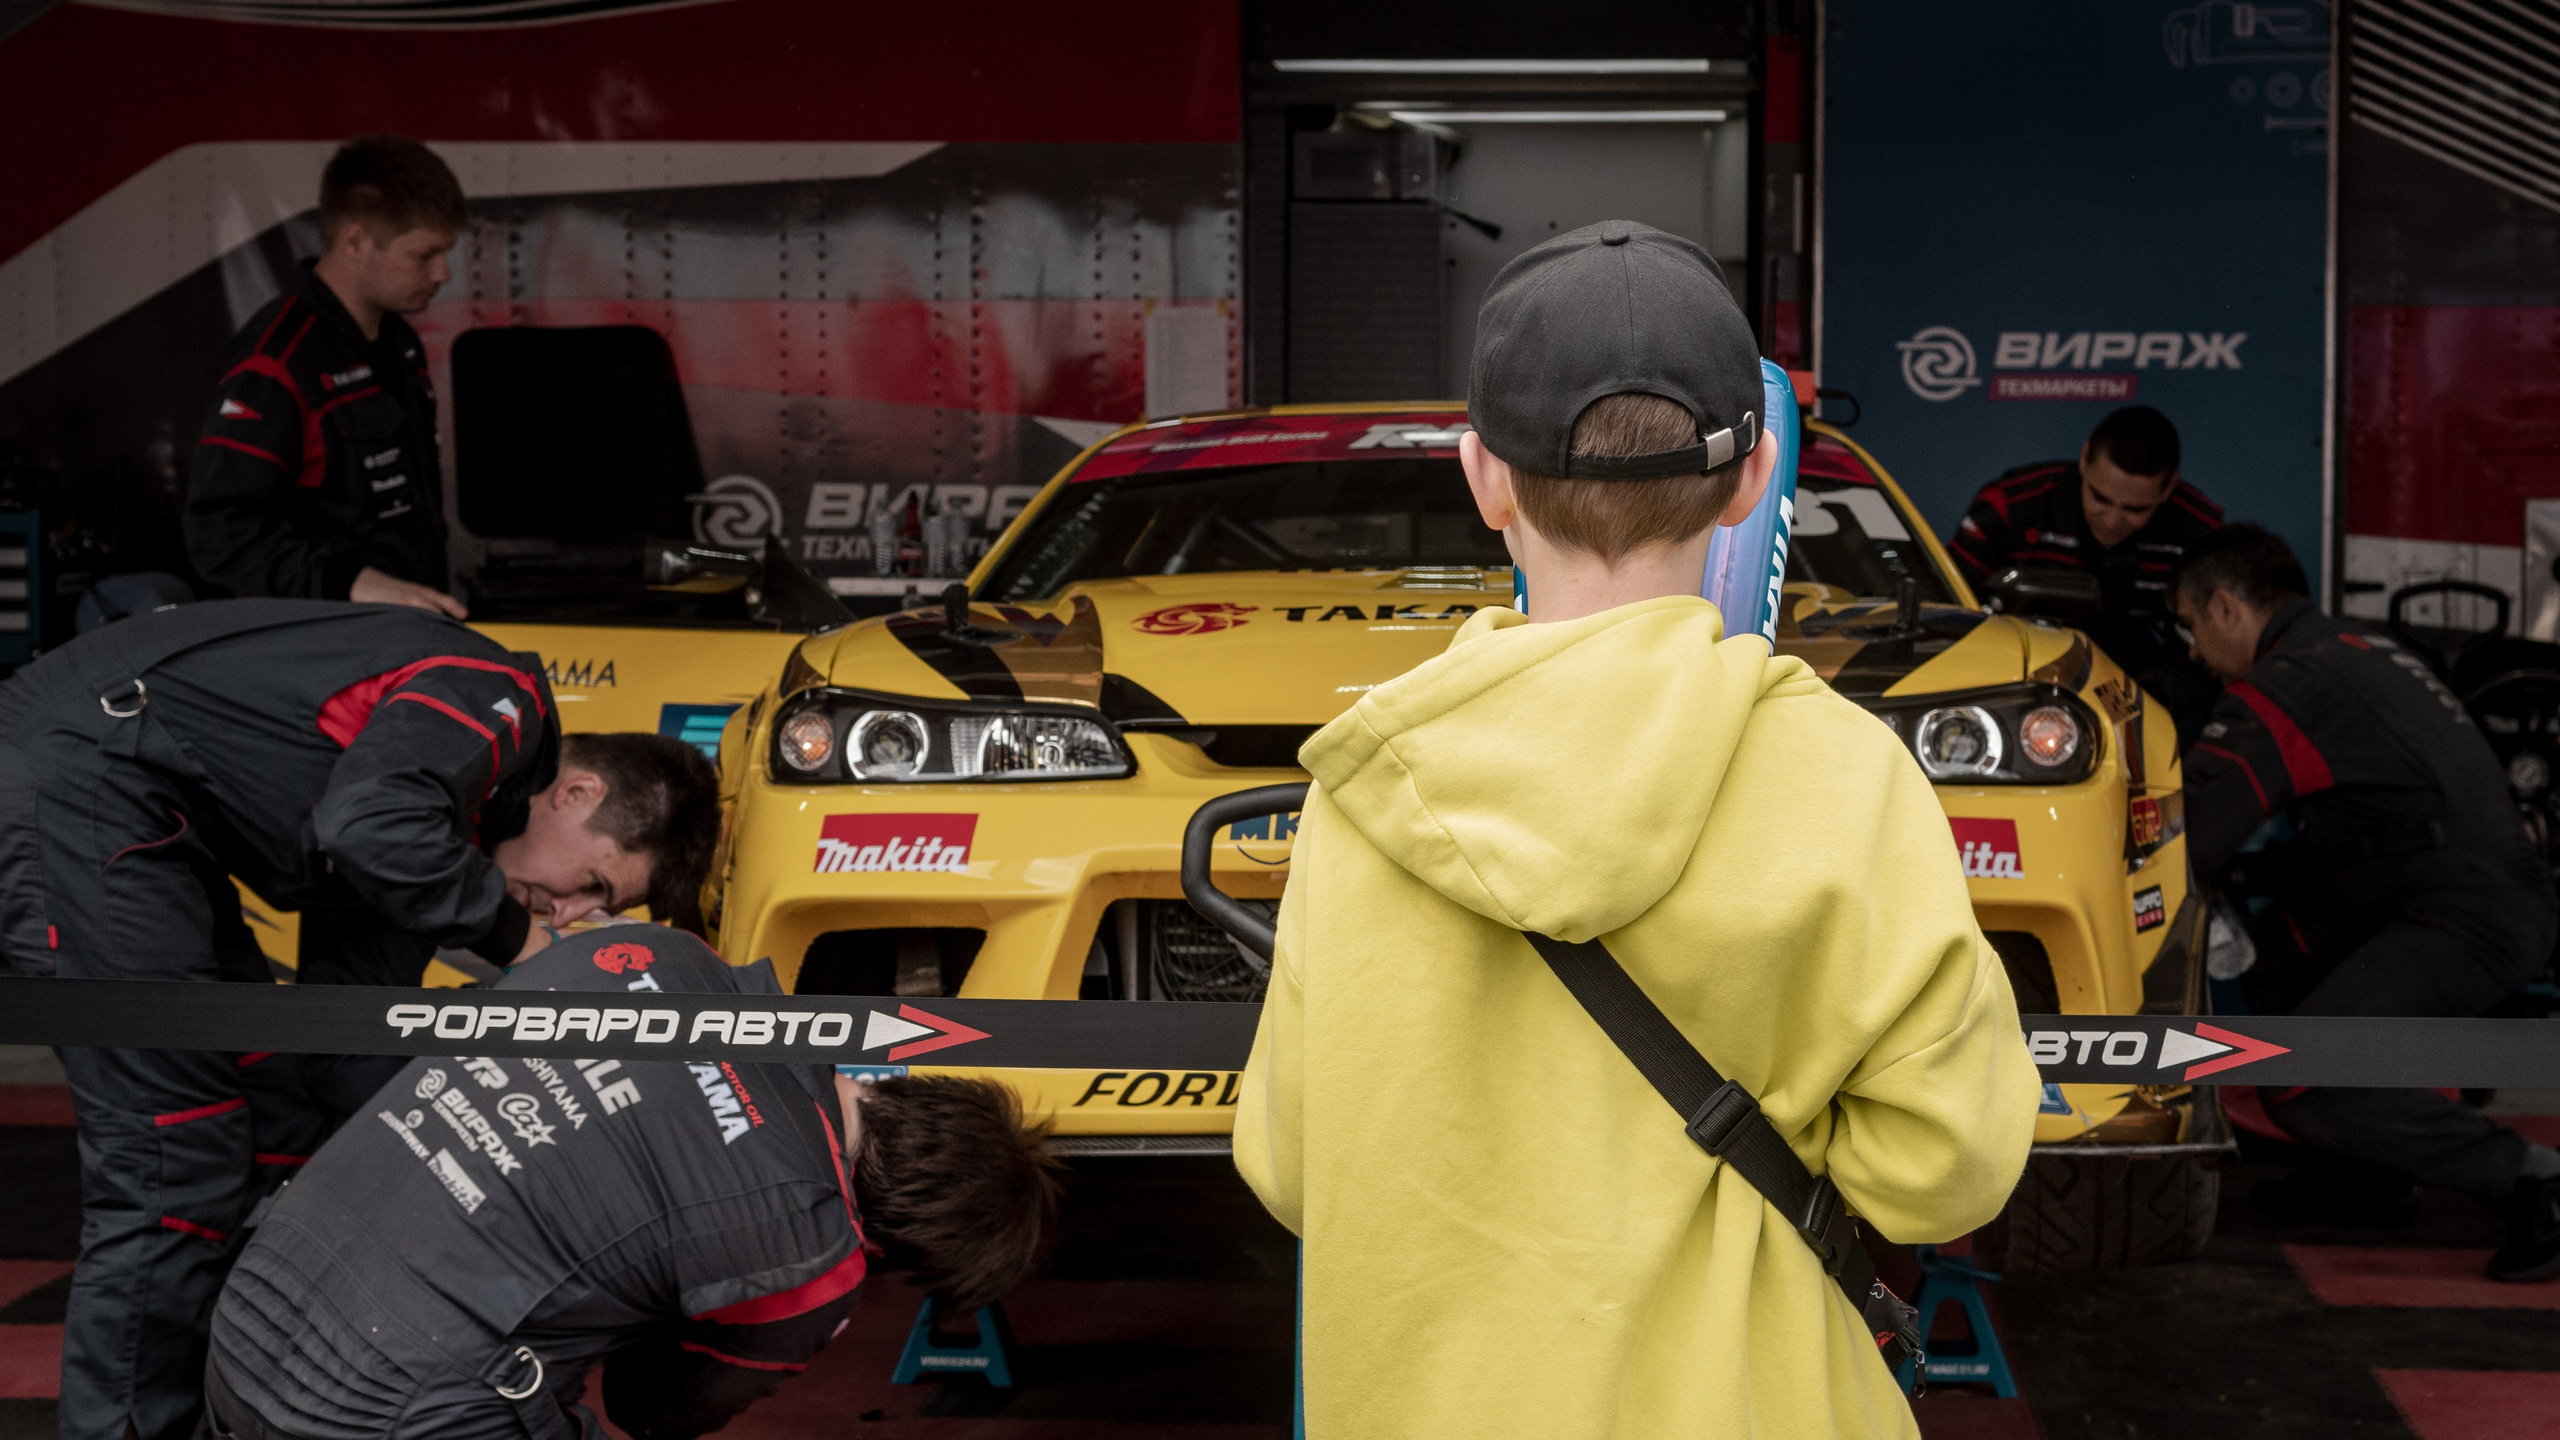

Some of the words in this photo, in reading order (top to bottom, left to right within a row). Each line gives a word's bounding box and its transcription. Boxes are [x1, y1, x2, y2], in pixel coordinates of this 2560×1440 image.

[1994, 331, 2249, 369] ВИРАЖ
[1997, 378, 2128, 397] ТЕХМАРКЕТЫ
[1273, 604, 1508, 622] TAKA
[1959, 840, 2026, 879] ita
[689, 1010, 853, 1047] АВТО
[2022, 1030, 2148, 1065] ВТО
[522, 1057, 589, 1131] SHIYAMA
[574, 1060, 642, 1116] LE
[431, 1098, 479, 1153] ТЕХМАРКЕТЫ
[438, 1086, 523, 1176] ВИРАЖ
[746, 1103, 765, 1129] OIL
